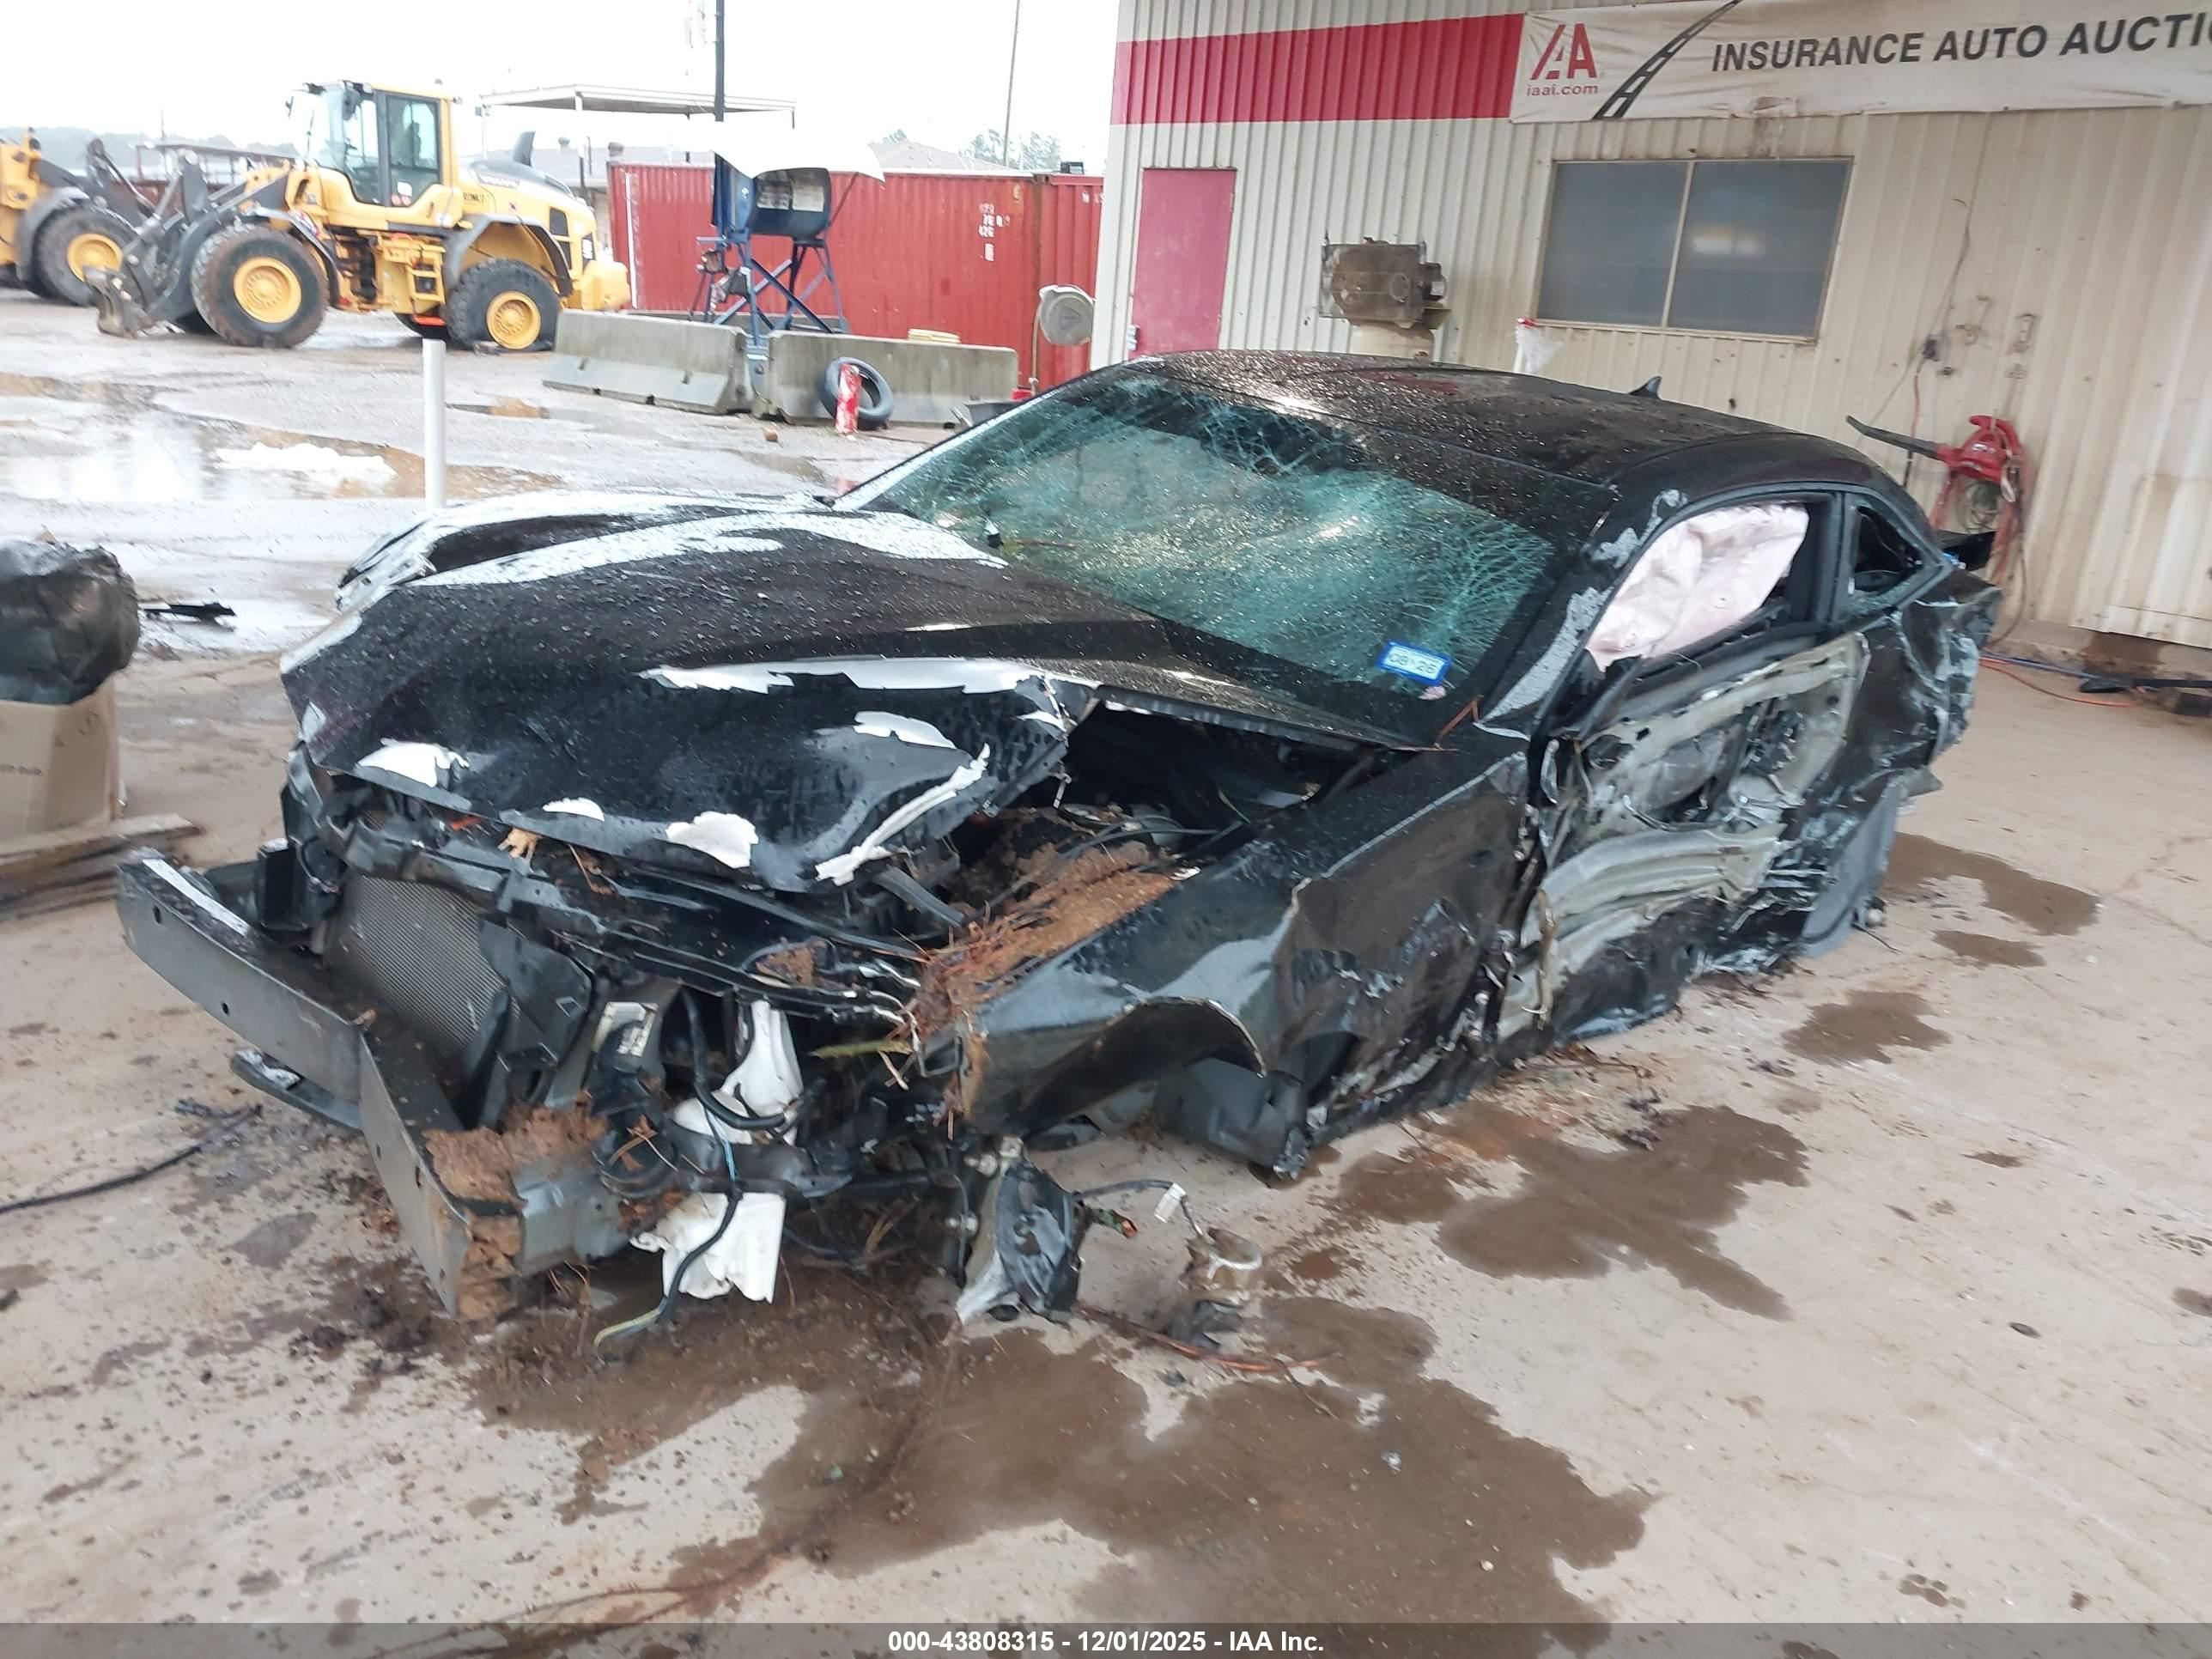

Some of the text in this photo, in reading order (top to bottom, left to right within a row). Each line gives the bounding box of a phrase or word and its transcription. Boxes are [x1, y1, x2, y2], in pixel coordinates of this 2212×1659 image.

[1712, 12, 2212, 72] INSURANCE AUTO AUCTI
[1527, 83, 1599, 96] iaai.com
